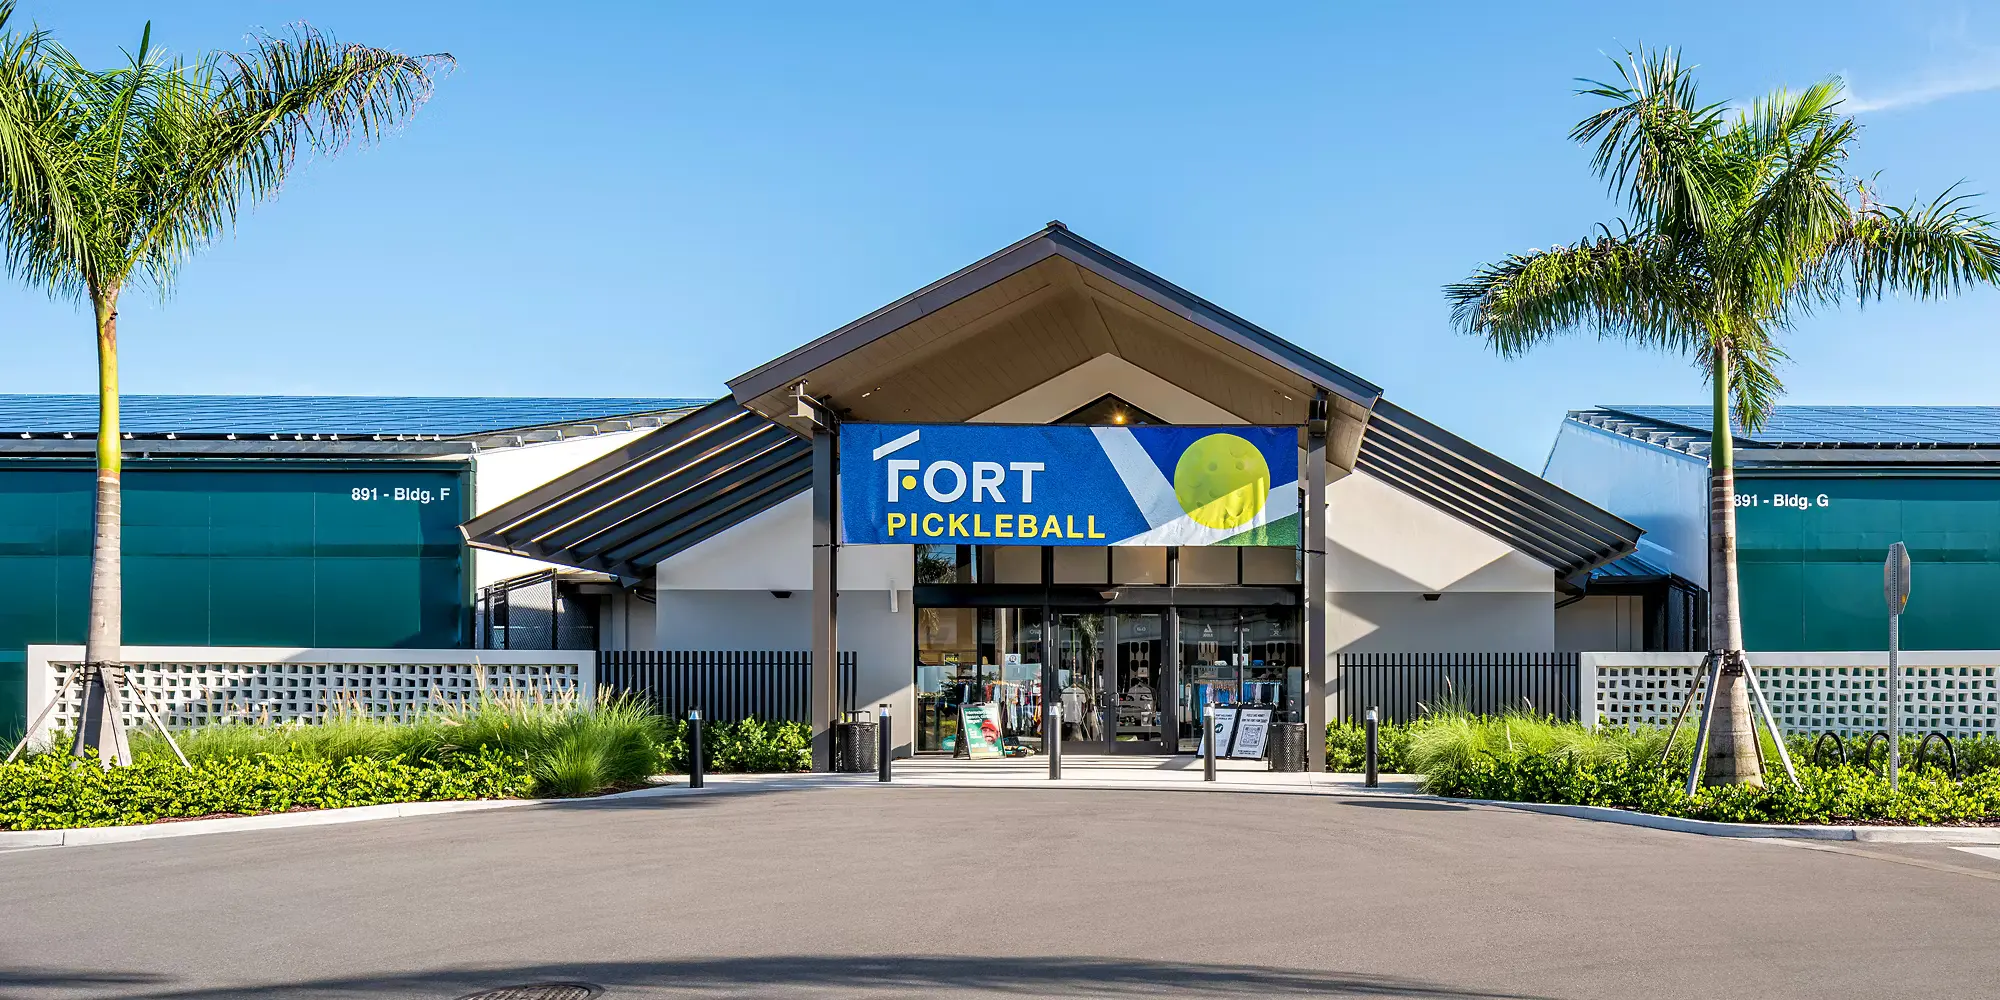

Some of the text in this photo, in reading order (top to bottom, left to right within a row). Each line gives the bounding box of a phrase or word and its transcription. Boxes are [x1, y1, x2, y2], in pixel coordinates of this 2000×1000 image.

[886, 458, 1046, 504] FORT
[351, 487, 378, 501] 891
[394, 487, 435, 504] Bldg.
[440, 487, 451, 501] F
[1773, 493, 1813, 510] Bldg.
[1816, 493, 1829, 507] G
[886, 512, 1107, 540] PICKLEBALL
